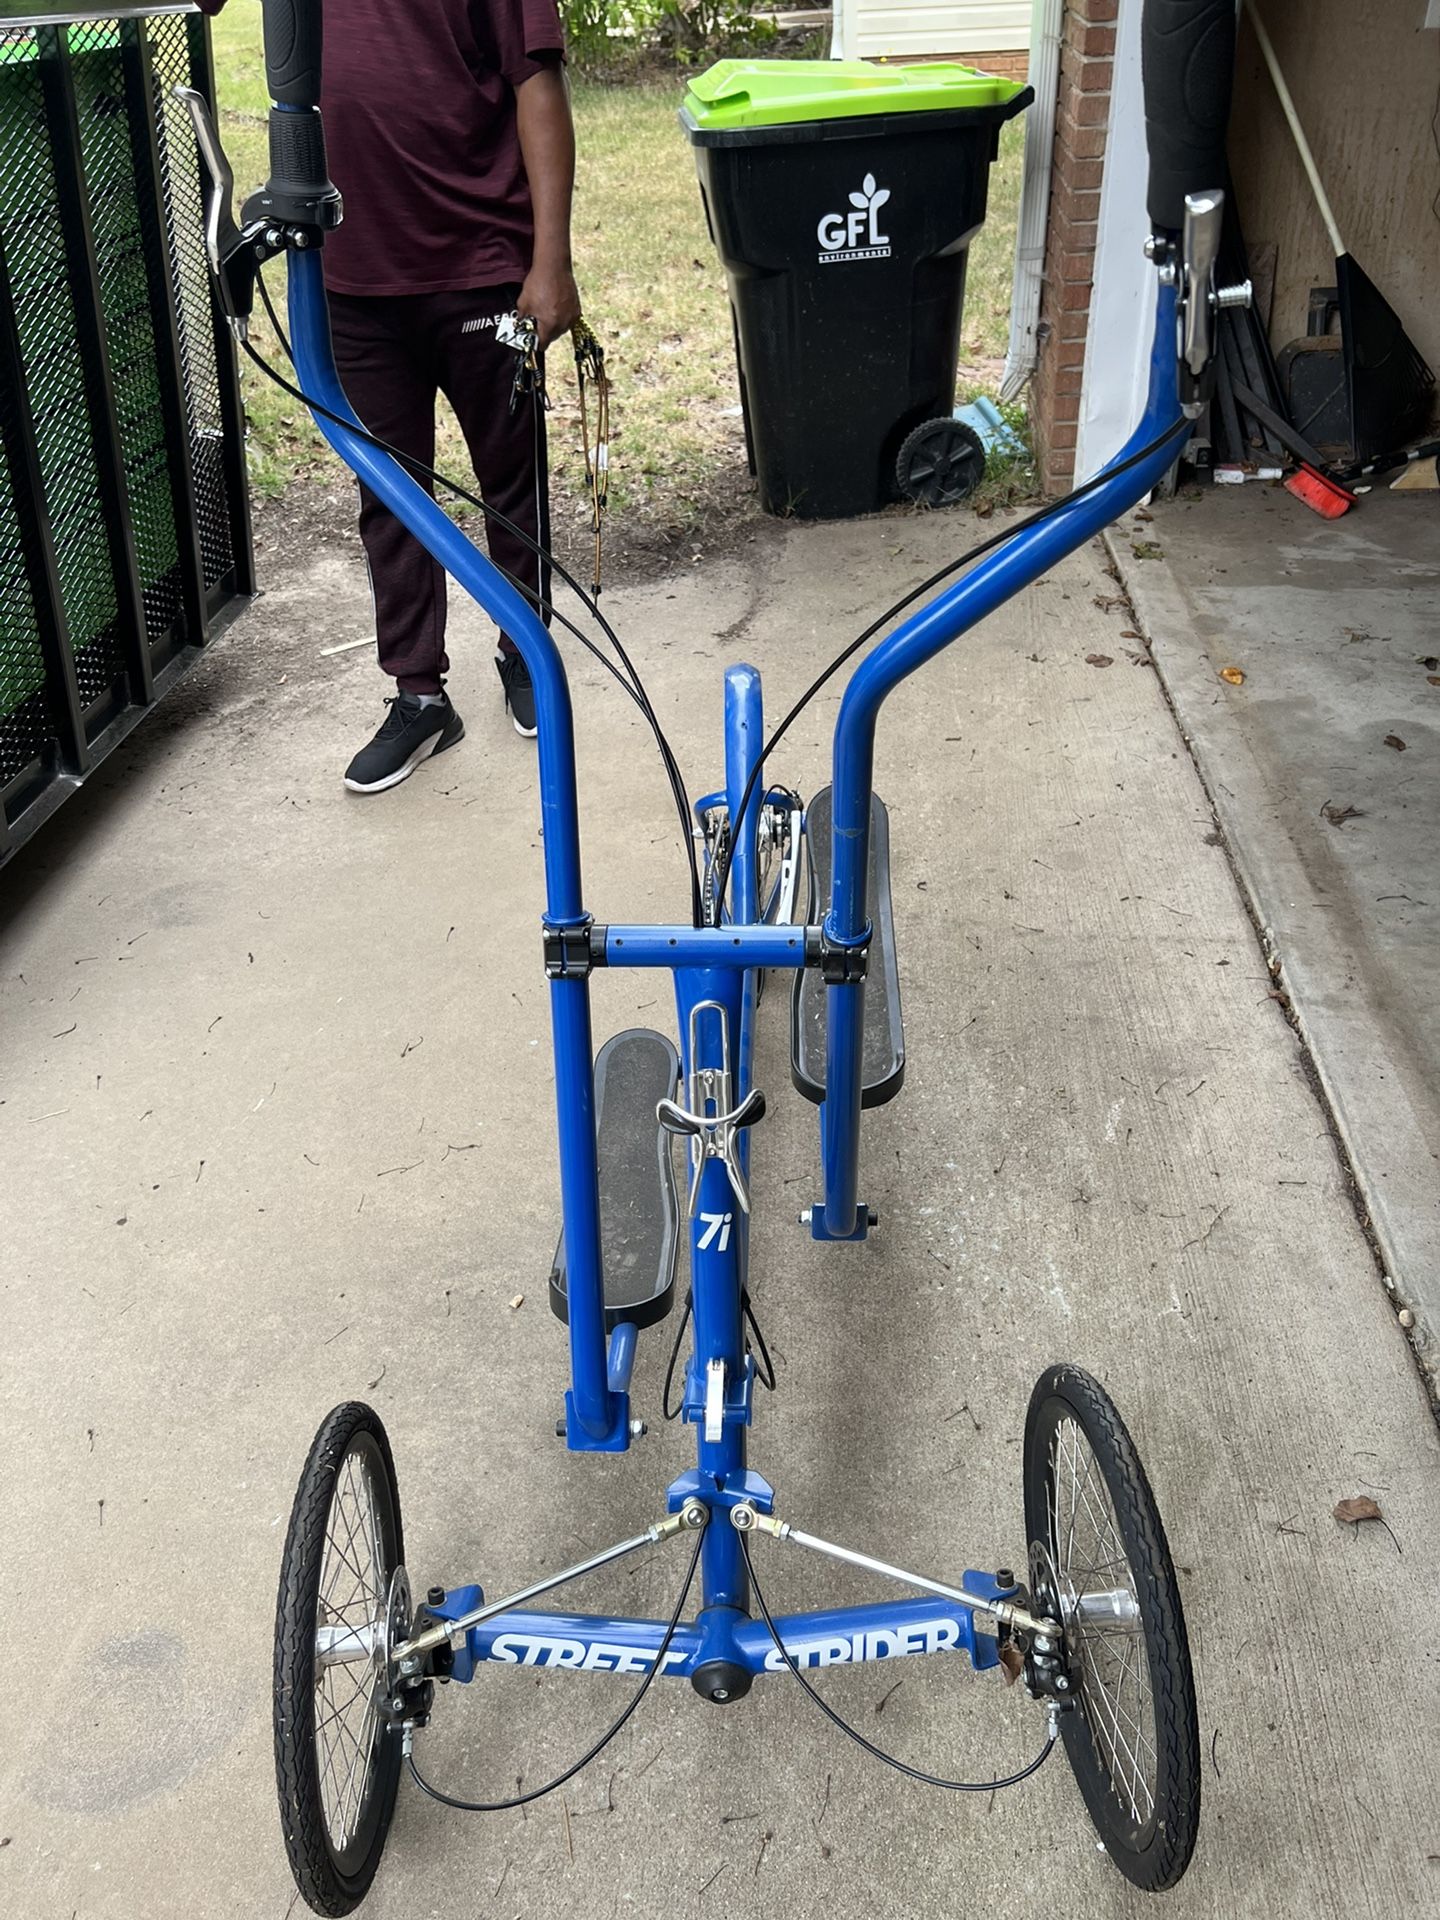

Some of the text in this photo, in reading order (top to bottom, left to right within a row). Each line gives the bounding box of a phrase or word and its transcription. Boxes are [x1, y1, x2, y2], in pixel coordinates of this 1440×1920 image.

[817, 189, 891, 251] GFL
[696, 1212, 733, 1252] 7i
[763, 1618, 960, 1672] STRIDER
